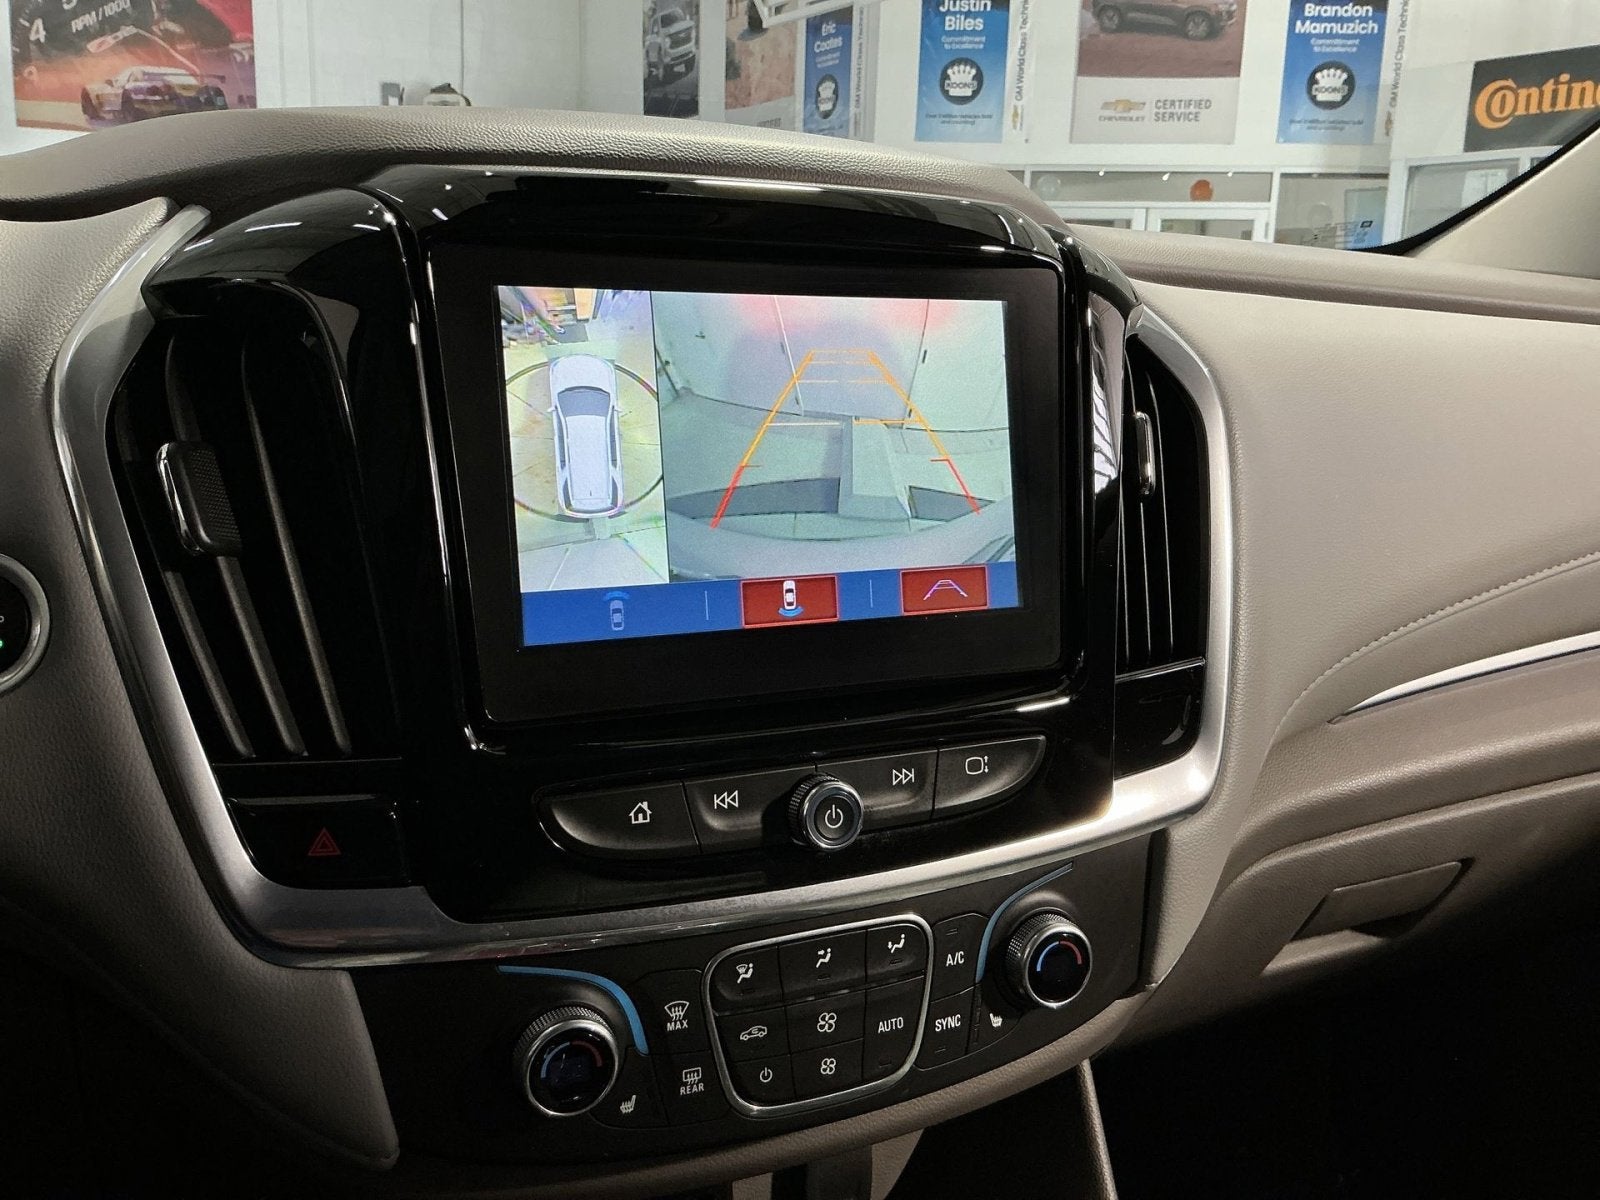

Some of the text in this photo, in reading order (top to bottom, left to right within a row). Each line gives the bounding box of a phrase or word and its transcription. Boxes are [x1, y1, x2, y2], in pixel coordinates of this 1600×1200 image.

[939, 0, 992, 12] Justin
[1304, 3, 1373, 17] Brandon
[71, 10, 97, 33] RPM
[944, 14, 984, 31] Biles
[1294, 19, 1379, 34] Mamuzich
[29, 18, 46, 43] 4
[1016, 58, 1026, 85] World
[1154, 99, 1212, 110] CERTIFIED
[1474, 72, 1600, 130] Contin
[1153, 111, 1201, 122] SERVICE
[945, 950, 965, 967] A/C
[666, 1019, 689, 1031] MAX
[877, 1015, 904, 1033] AUTO
[934, 1013, 962, 1032] SYNC
[679, 1082, 705, 1096] REAR
